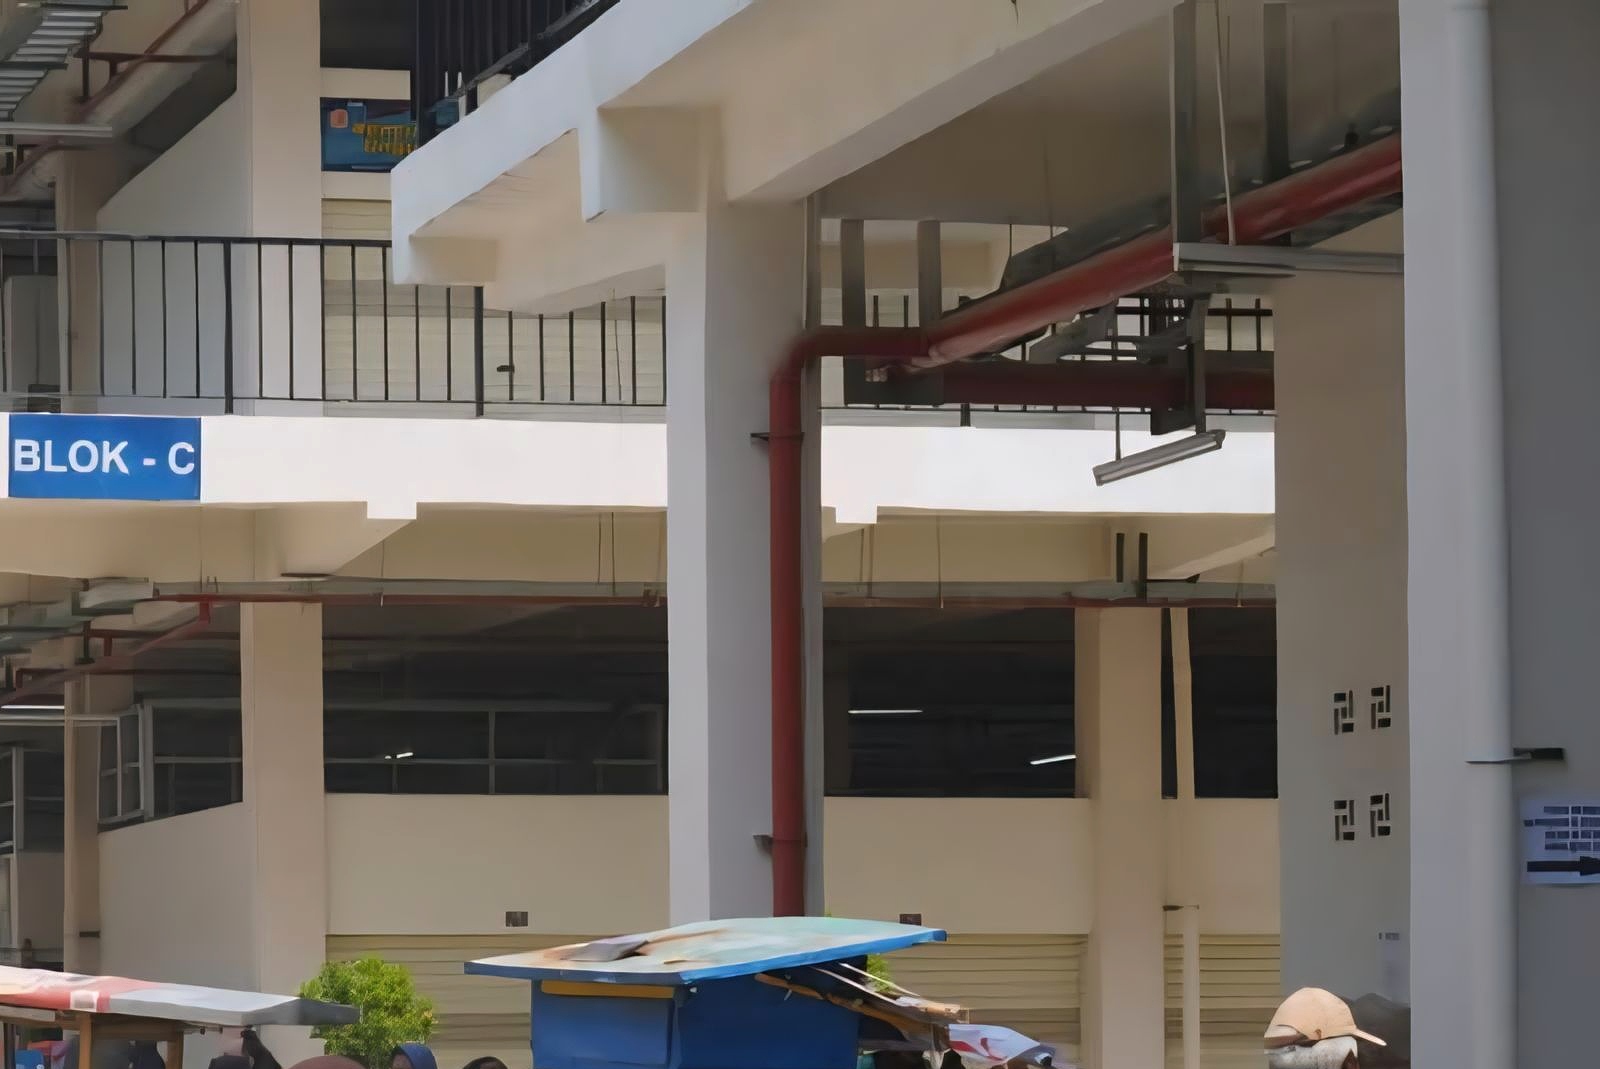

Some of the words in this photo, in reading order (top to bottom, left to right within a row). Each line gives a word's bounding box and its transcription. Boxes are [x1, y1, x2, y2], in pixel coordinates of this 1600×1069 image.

[14, 438, 130, 475] BLOK
[142, 457, 157, 467] -
[167, 441, 195, 475] C
